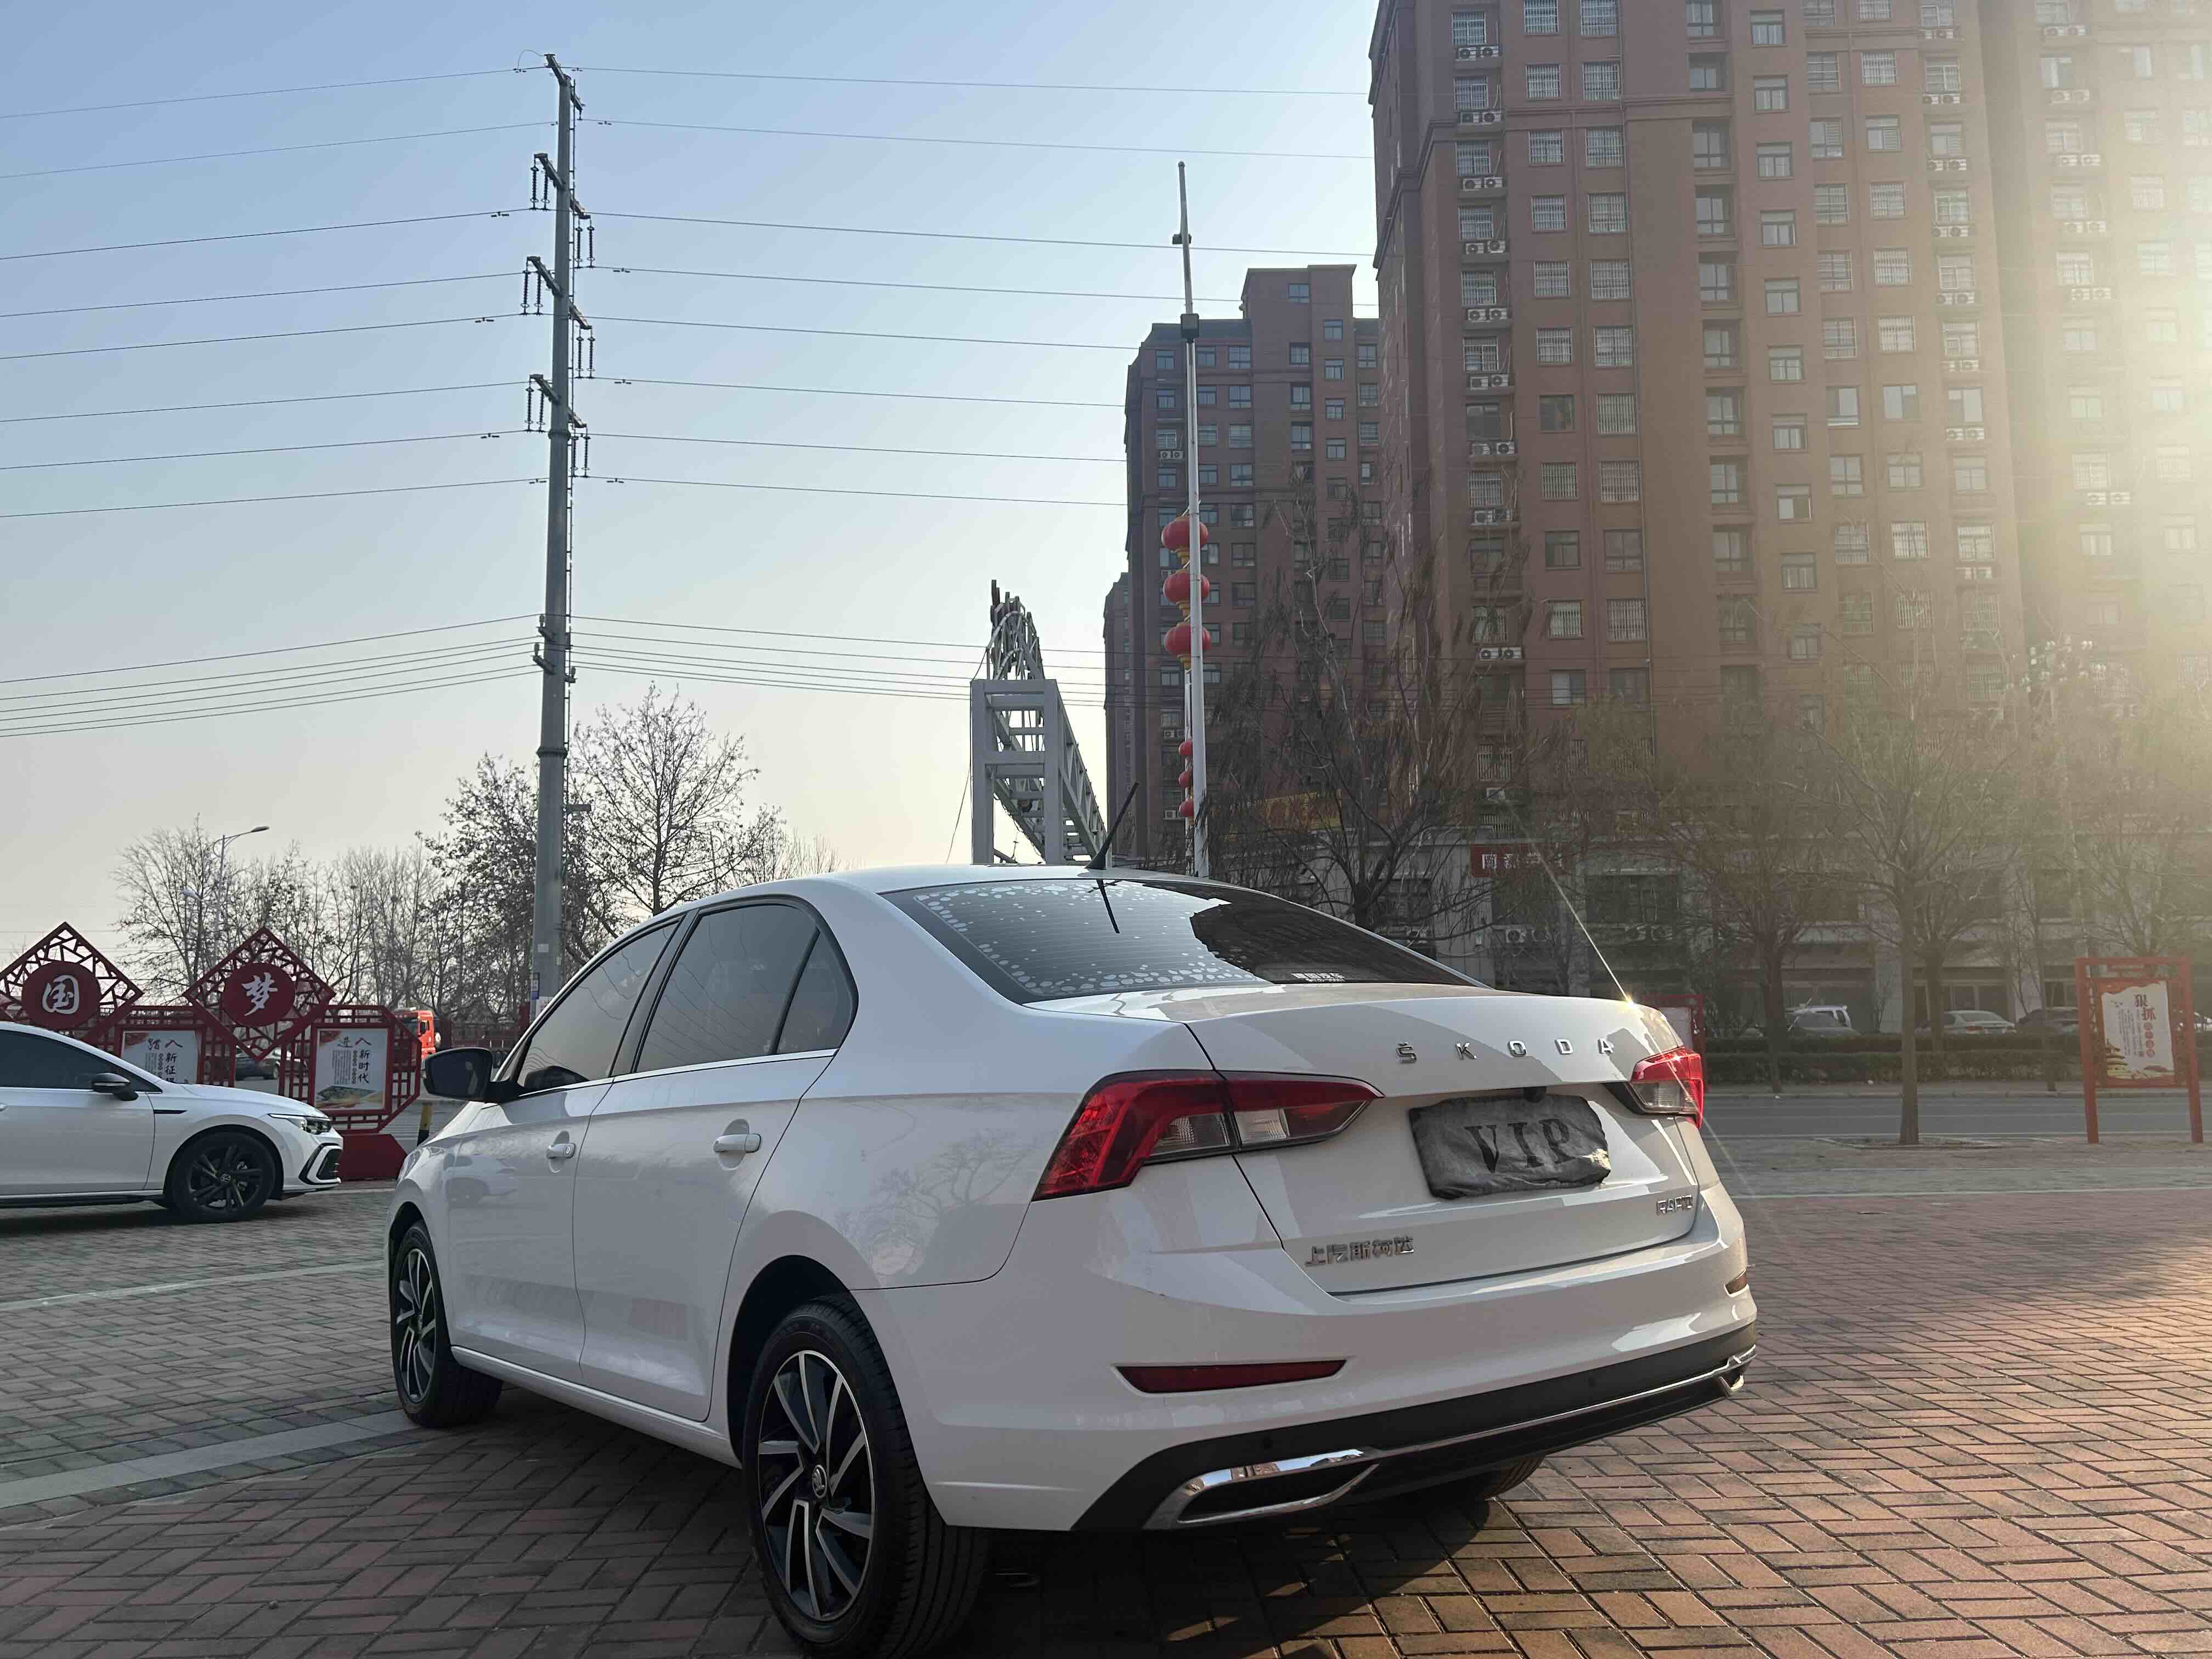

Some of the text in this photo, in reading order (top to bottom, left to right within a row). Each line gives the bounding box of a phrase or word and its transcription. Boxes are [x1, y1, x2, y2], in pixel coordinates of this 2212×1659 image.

[42, 972, 279, 1017] 国 梦
[1463, 1118, 1577, 1173] VIP
[1305, 1235, 1415, 1267] 上汽斯柯达
